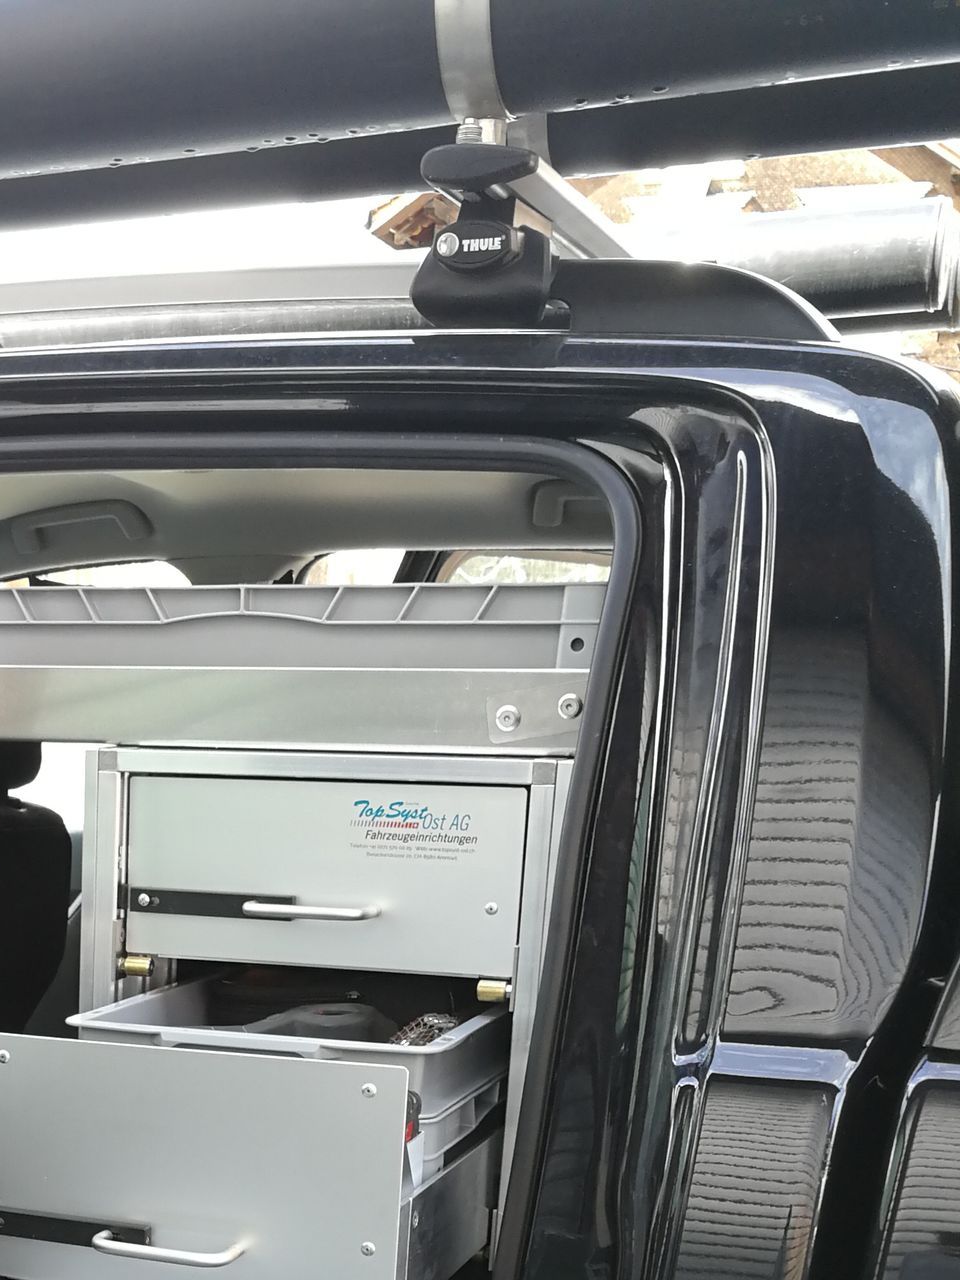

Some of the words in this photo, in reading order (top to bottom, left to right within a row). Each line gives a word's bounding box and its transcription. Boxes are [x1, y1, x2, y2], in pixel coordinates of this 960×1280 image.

[462, 237, 502, 252] THULE
[422, 813, 446, 830] Ost
[449, 814, 471, 831] AG
[365, 829, 478, 846] Fahrzeugeinrichtungen
